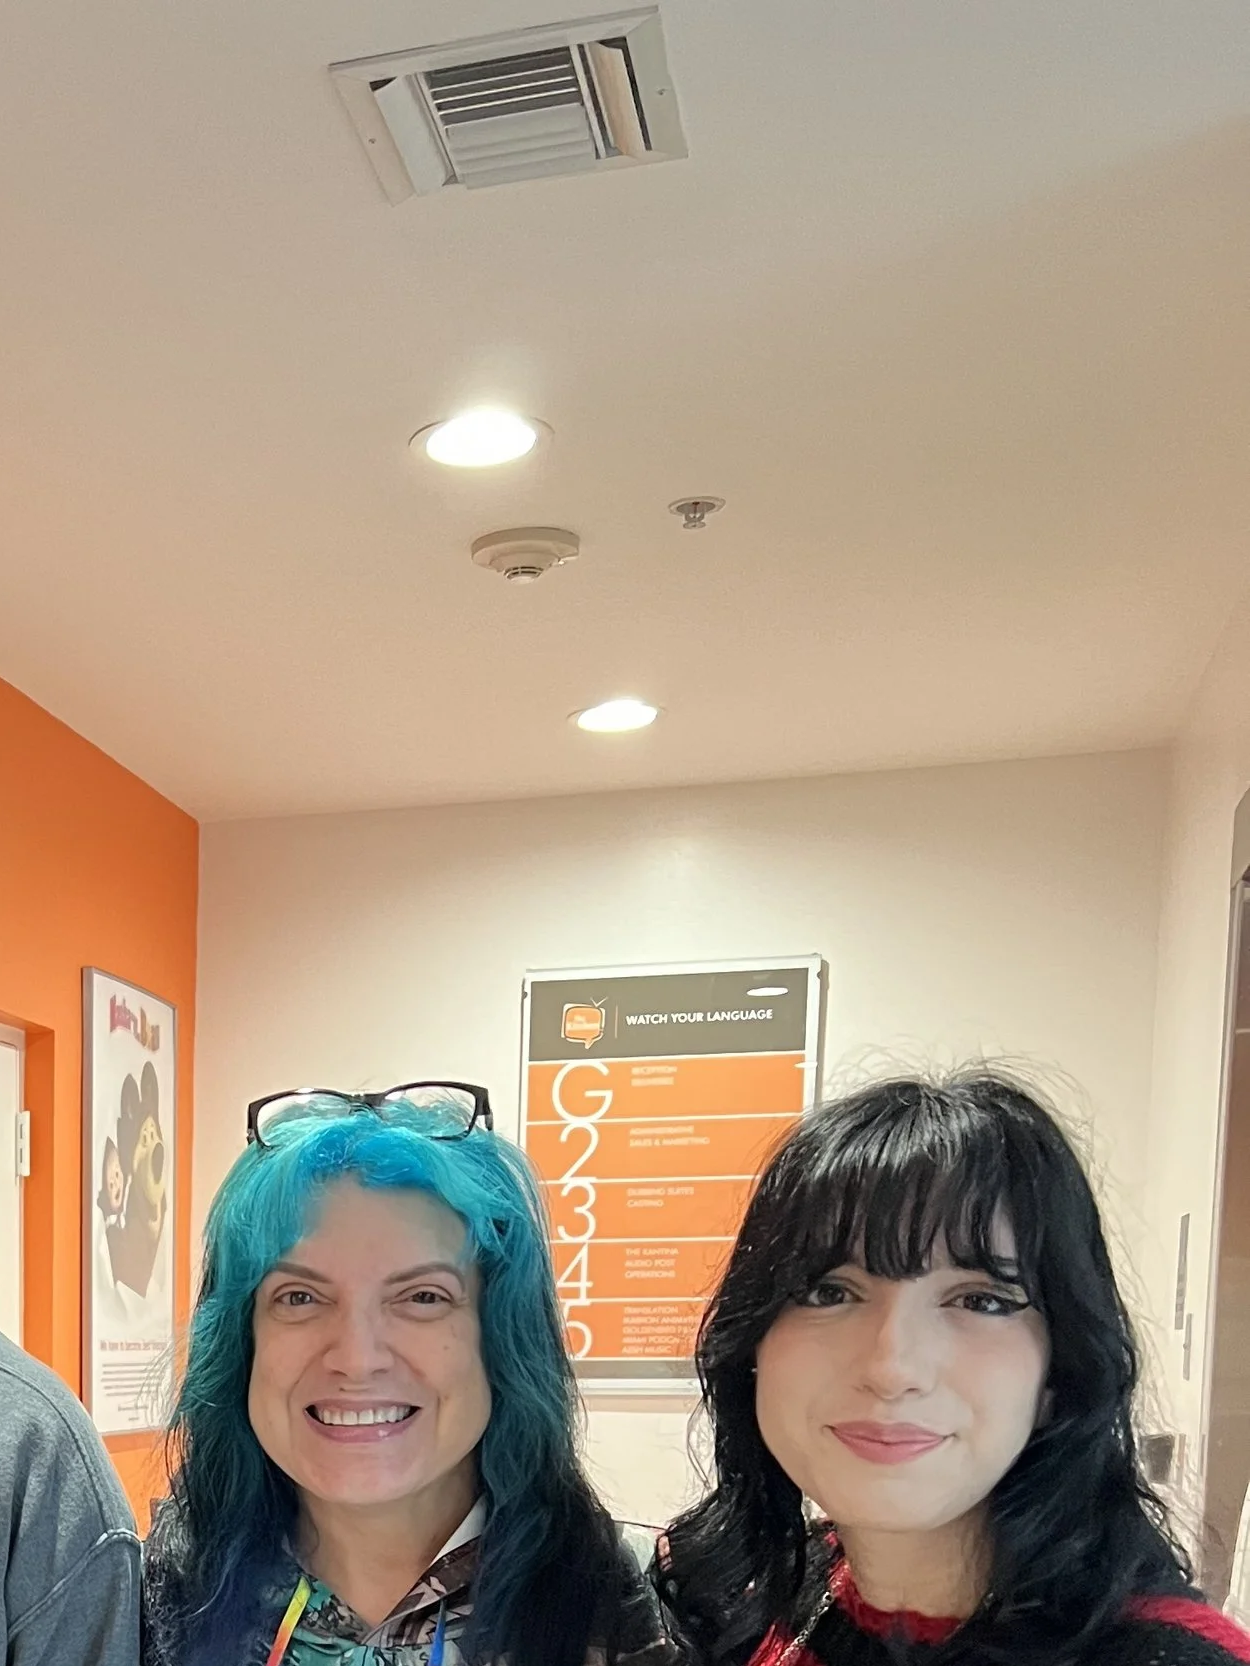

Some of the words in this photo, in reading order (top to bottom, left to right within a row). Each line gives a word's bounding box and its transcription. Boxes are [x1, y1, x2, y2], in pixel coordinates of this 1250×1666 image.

[625, 1013, 668, 1026] WATCH
[670, 1011, 704, 1024] YOUR
[706, 1008, 773, 1022] LANGUAGE
[552, 1059, 614, 1123] G
[559, 1121, 600, 1183] 2
[557, 1180, 597, 1242] 3
[556, 1241, 594, 1302] 4
